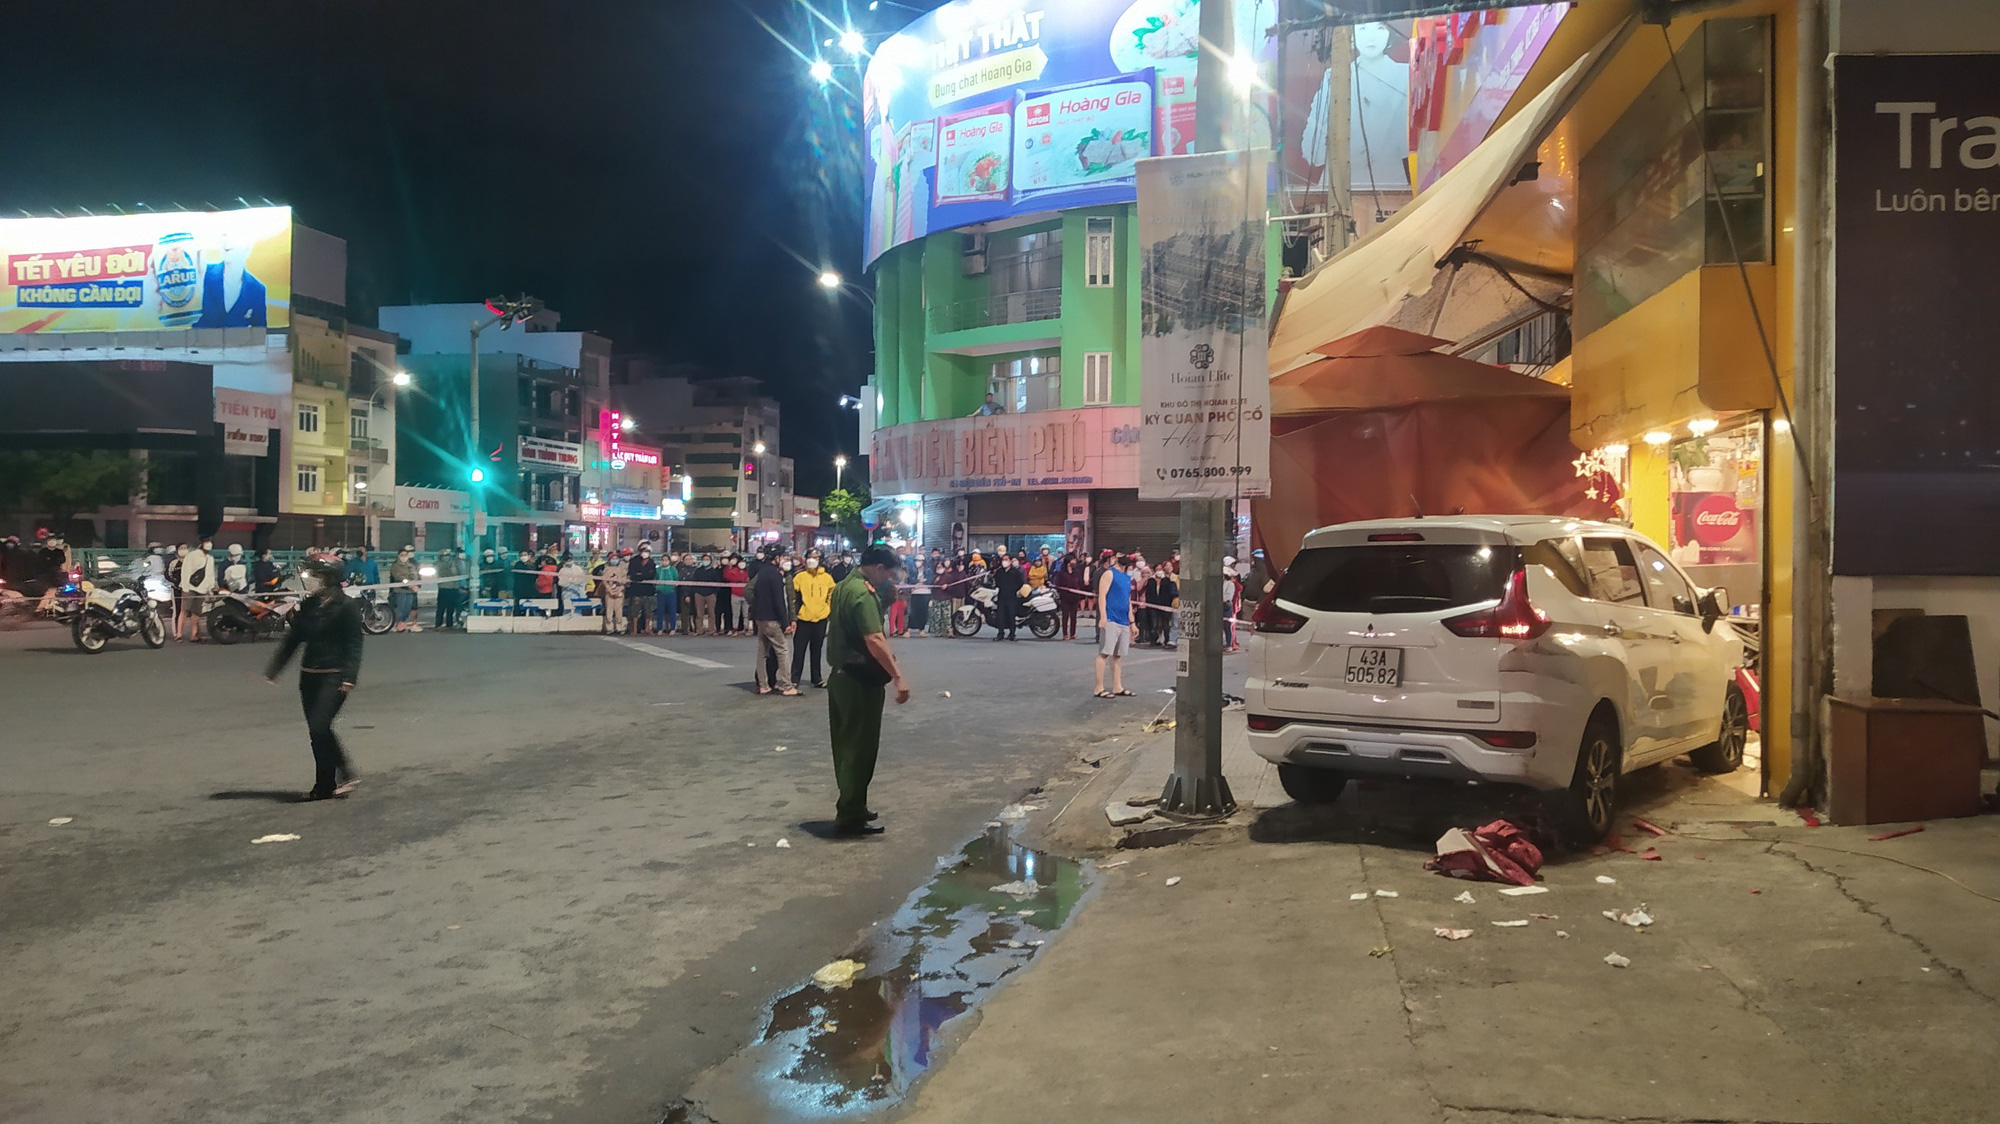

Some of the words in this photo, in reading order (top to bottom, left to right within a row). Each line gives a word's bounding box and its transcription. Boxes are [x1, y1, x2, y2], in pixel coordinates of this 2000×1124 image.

[1059, 97, 1110, 115] Hoàng
[1875, 187, 1946, 212] Luôn
[13, 254, 54, 280] TẾT
[55, 253, 102, 278] YÊU
[20, 285, 77, 302] KHÔNG
[1170, 466, 1252, 479] 0765.800.999
[408, 497, 440, 510] Canon
[1697, 511, 1741, 526] Coca-Cola
[1182, 601, 1200, 609] VAY
[1360, 649, 1387, 666] 43A
[1347, 666, 1397, 685] 505.82
